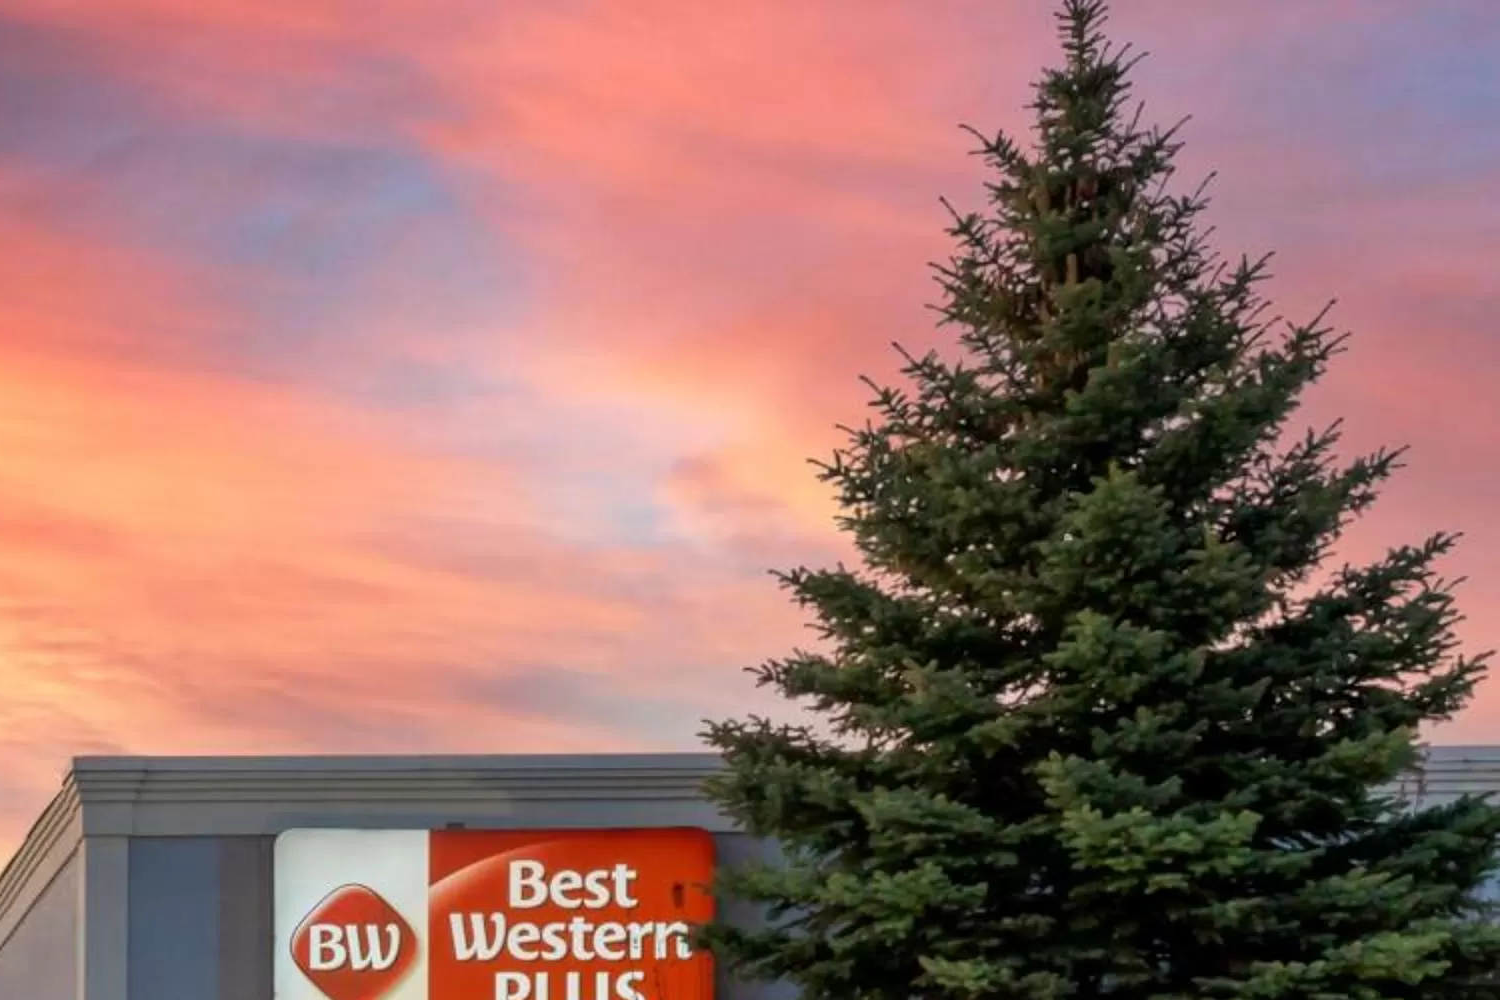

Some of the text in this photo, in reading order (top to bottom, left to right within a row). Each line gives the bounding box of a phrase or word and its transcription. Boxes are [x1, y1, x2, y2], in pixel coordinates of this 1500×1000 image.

[509, 860, 638, 908] Best
[309, 923, 400, 971] BW
[449, 911, 692, 961] Western
